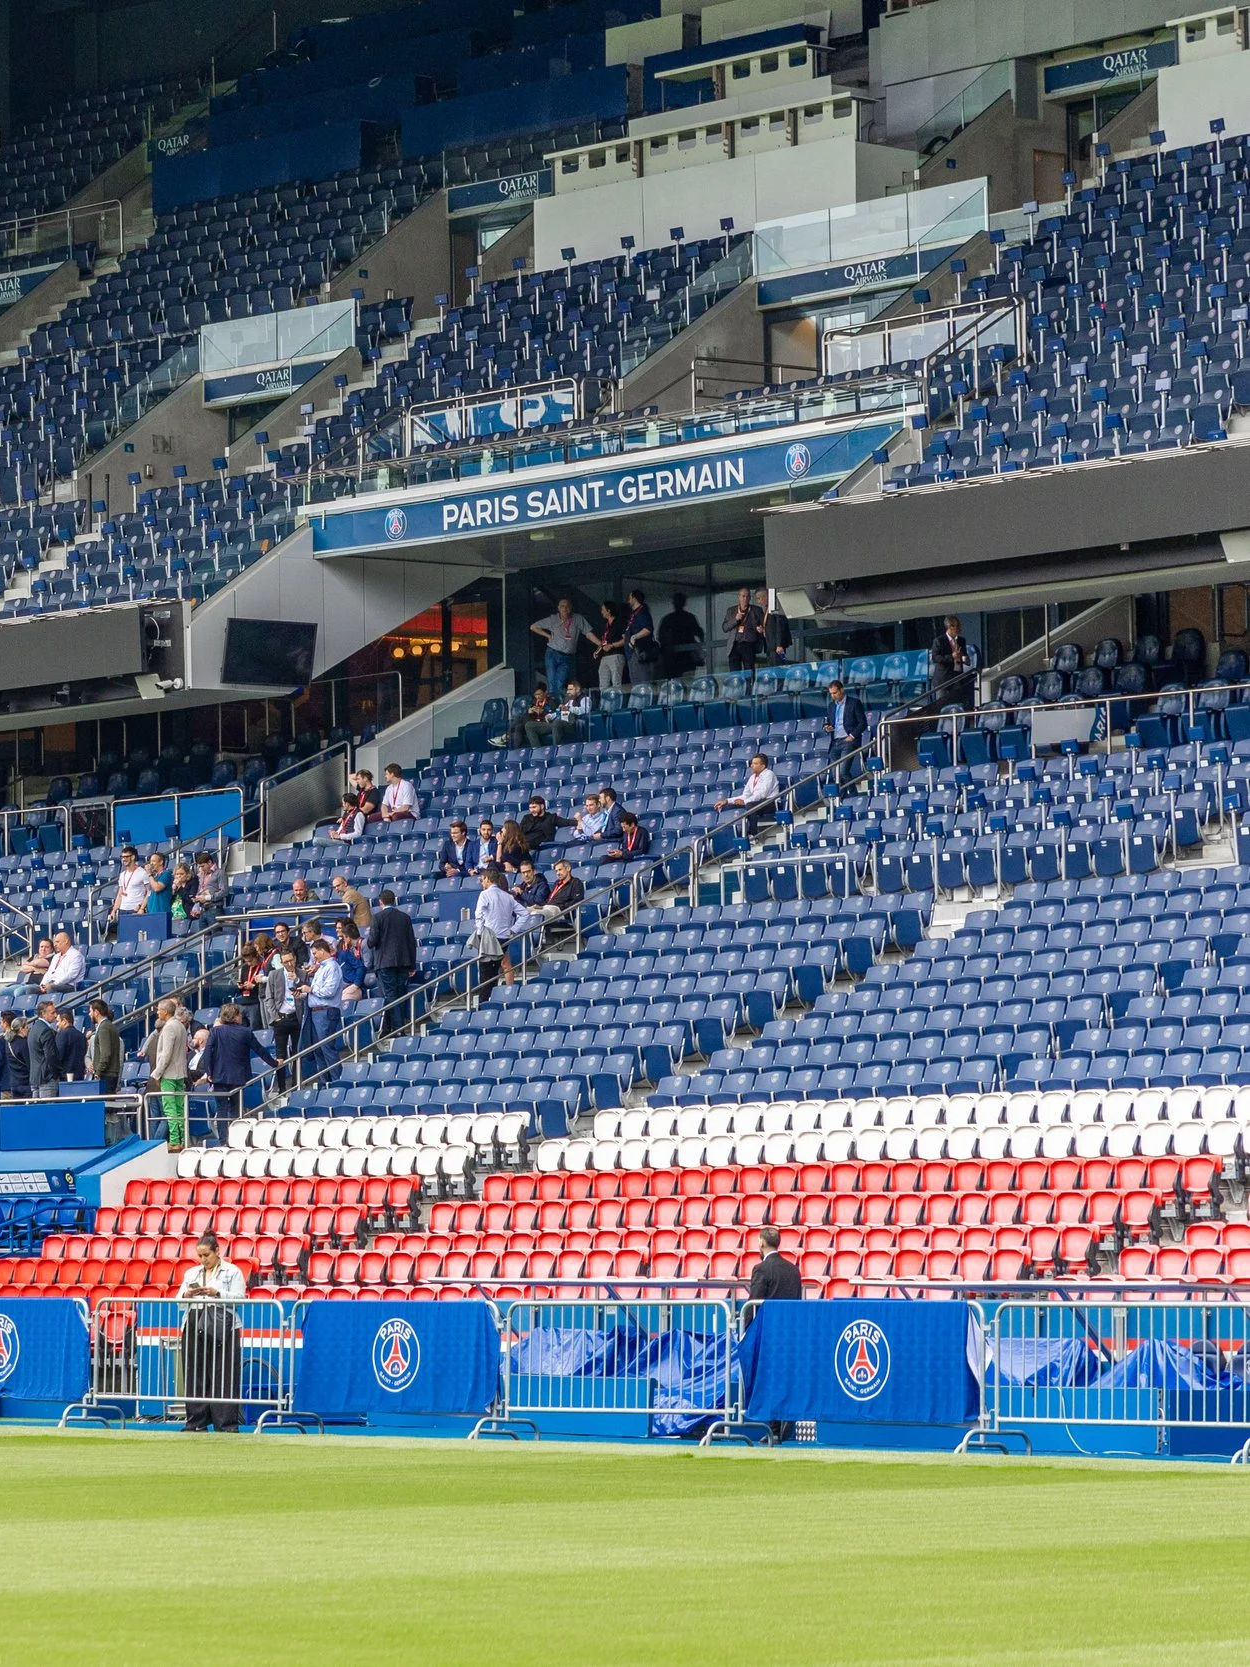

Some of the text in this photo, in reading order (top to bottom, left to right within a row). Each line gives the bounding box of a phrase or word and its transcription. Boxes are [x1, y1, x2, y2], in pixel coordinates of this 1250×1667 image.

[1103, 48, 1147, 72] QATAR
[1114, 62, 1149, 77] AIRWAYS
[157, 134, 189, 152] QATAR
[498, 174, 537, 195] QATAR
[508, 187, 538, 200] AIRWAYS
[844, 260, 887, 280] QATAR
[854, 272, 888, 286] AIRWAYS
[256, 368, 290, 386] QATAR
[264, 379, 290, 391] AIRWAYS
[442, 457, 745, 531] PARIS SAINT-GERMAIN
[380, 1322, 411, 1340] PARIS
[844, 1323, 881, 1344] PARIS
